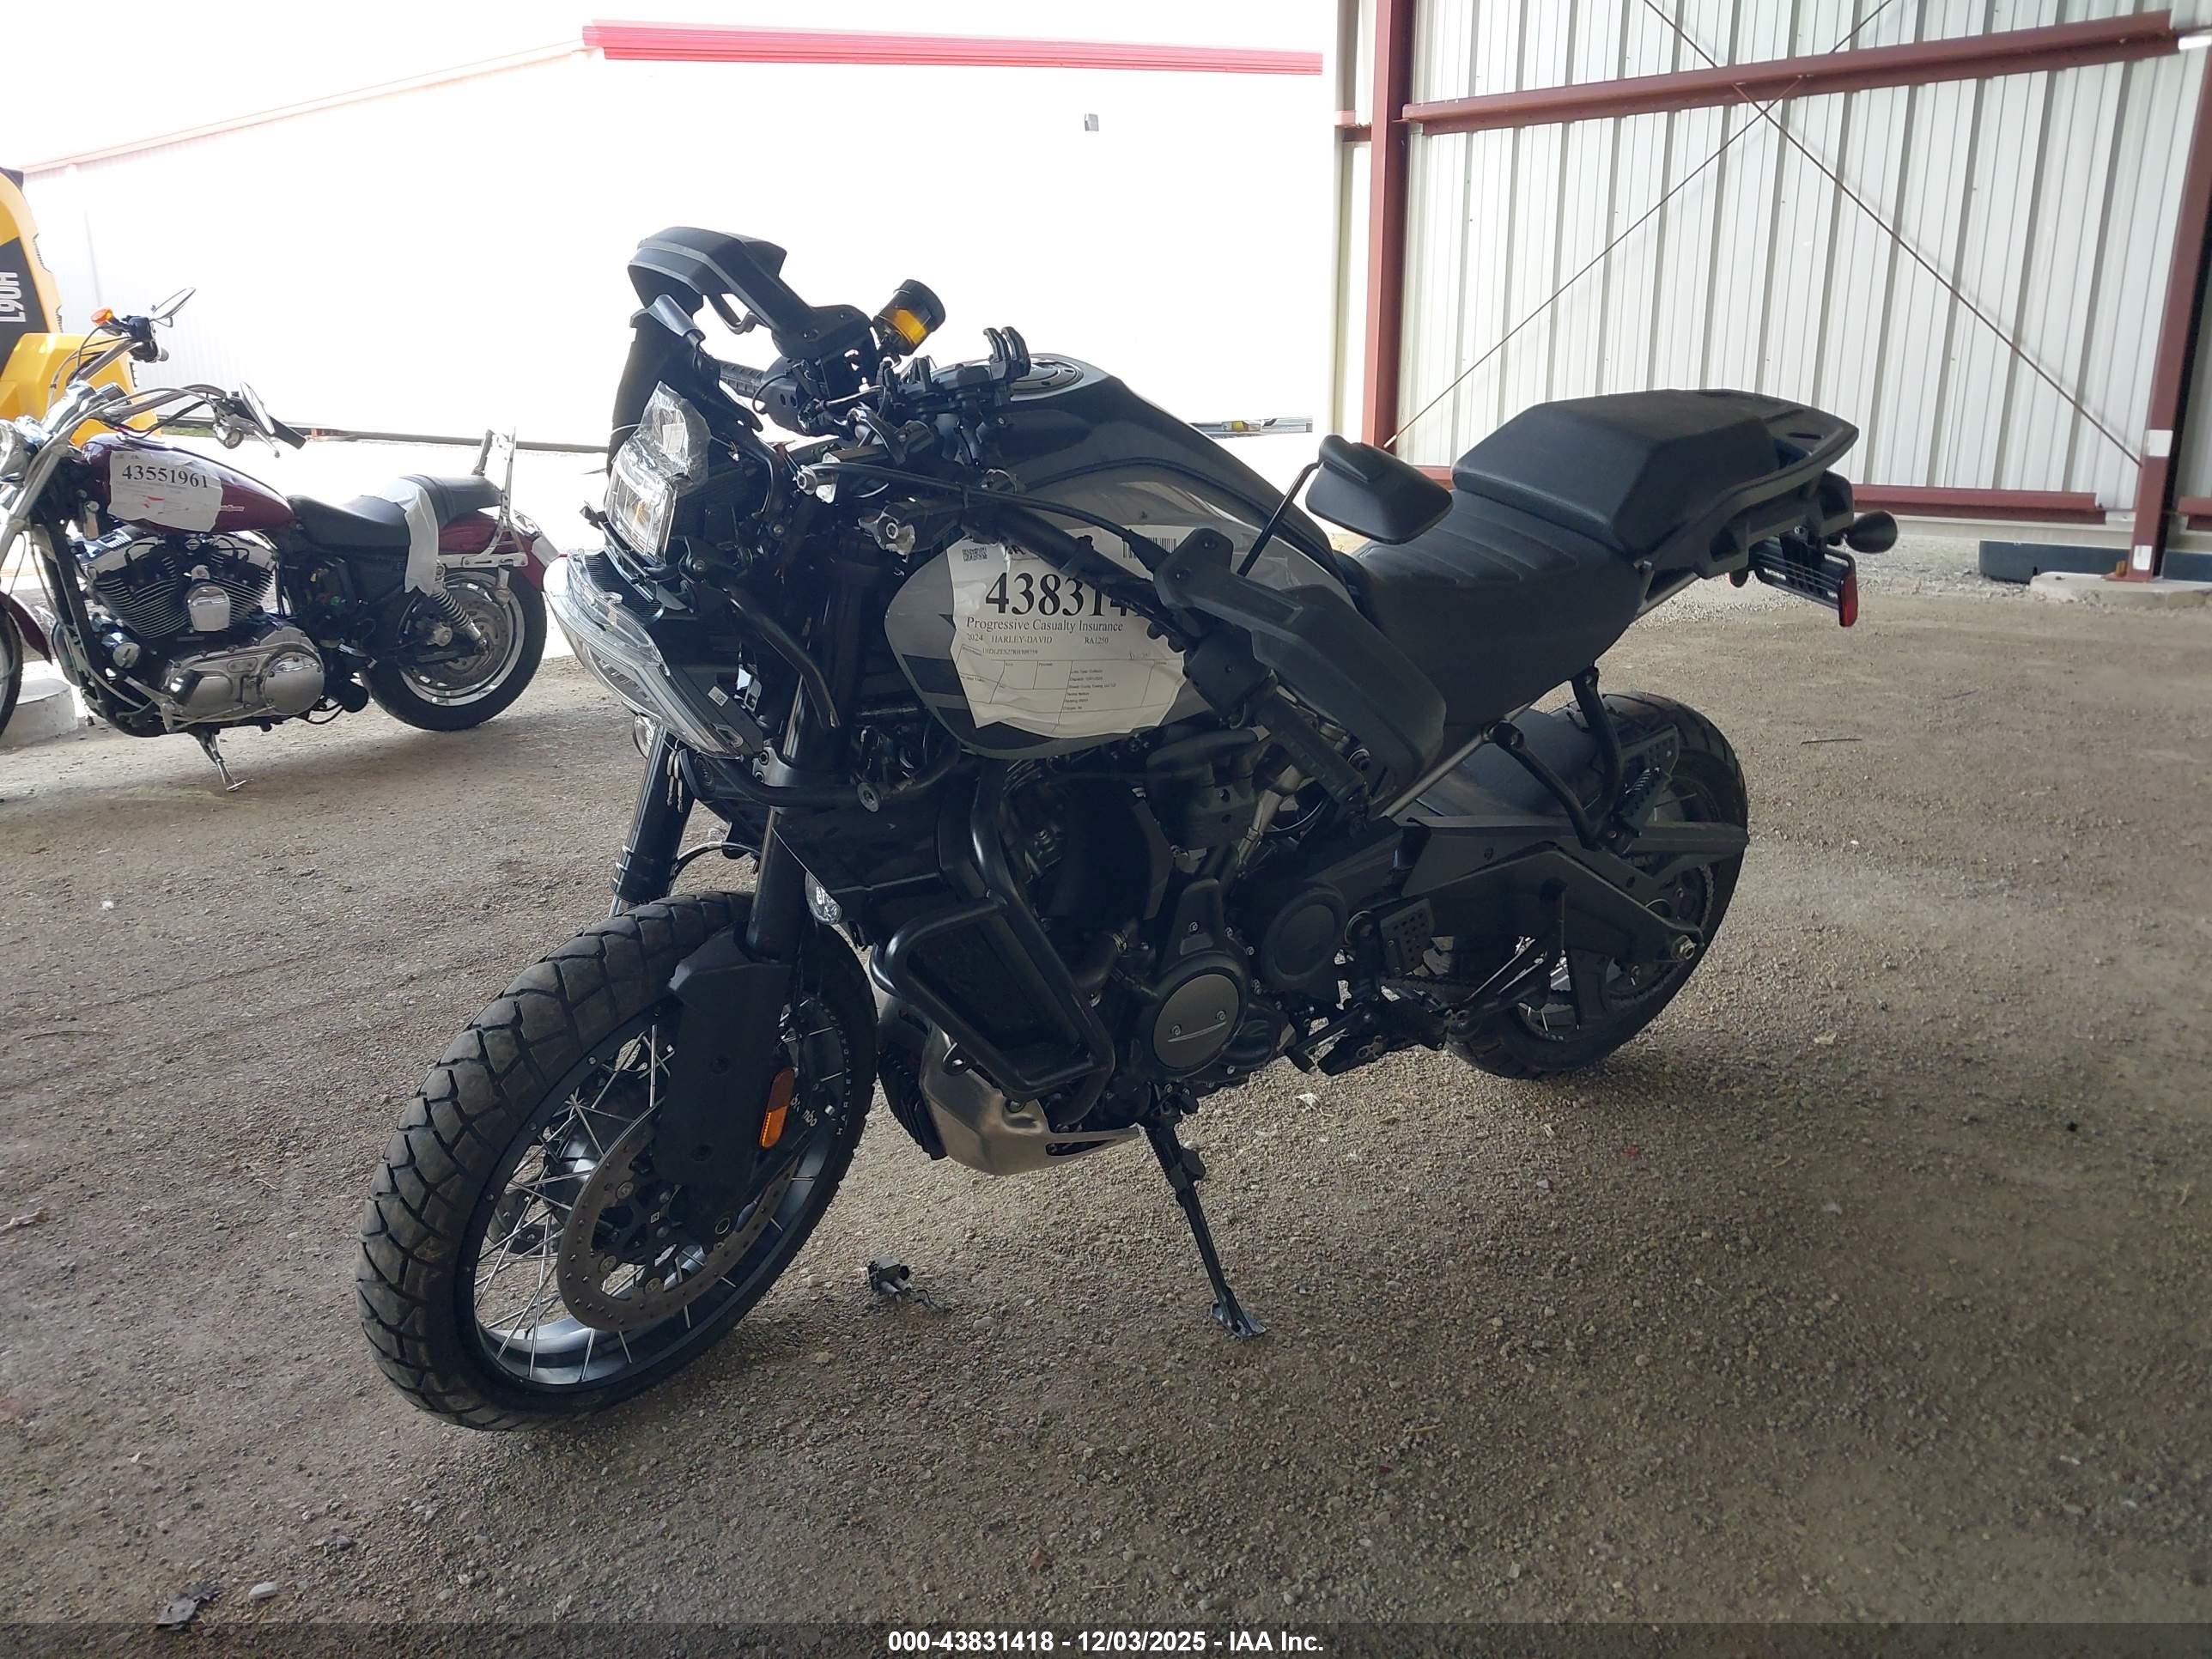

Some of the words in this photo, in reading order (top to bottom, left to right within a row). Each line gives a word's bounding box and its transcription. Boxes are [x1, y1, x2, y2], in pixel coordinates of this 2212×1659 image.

[122, 465, 208, 489] 43551961
[985, 573, 1142, 617] 43831
[966, 617, 1030, 633] Progressive
[1032, 619, 1076, 634] Casualty
[1079, 620, 1123, 632] Insurance
[967, 633, 983, 641] 2024
[991, 635, 1053, 644] HARLEY-DAVID
[1085, 636, 1109, 645] RA1250
